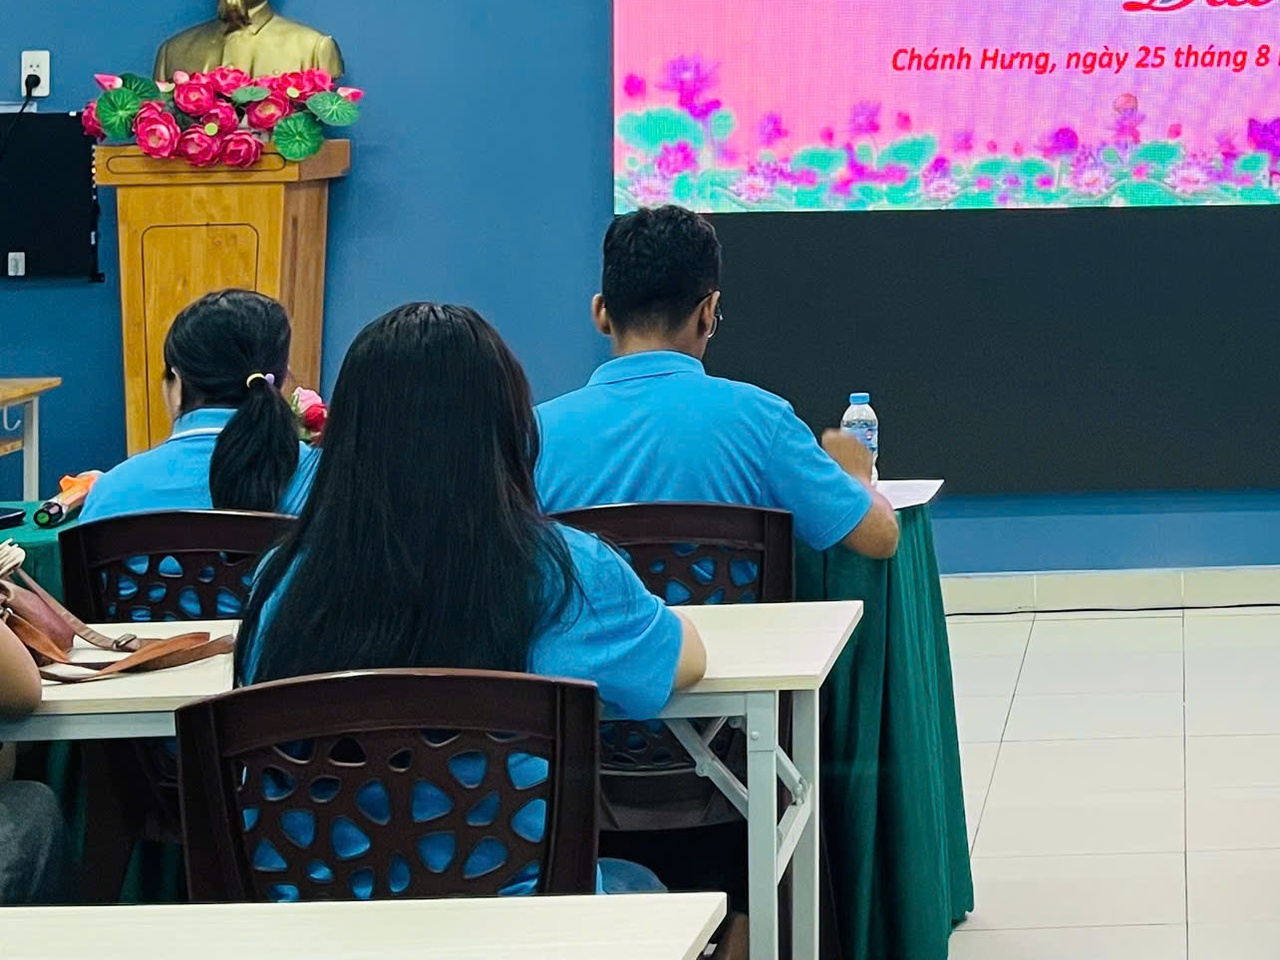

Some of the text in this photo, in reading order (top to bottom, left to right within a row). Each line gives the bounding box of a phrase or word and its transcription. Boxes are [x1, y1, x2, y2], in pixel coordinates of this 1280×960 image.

[891, 46, 972, 71] Chánh
[980, 48, 1057, 74] Hưng,
[1065, 45, 1129, 74] ngày
[1135, 45, 1166, 69] 25
[1174, 44, 1248, 73] tháng
[1254, 44, 1270, 67] 8
